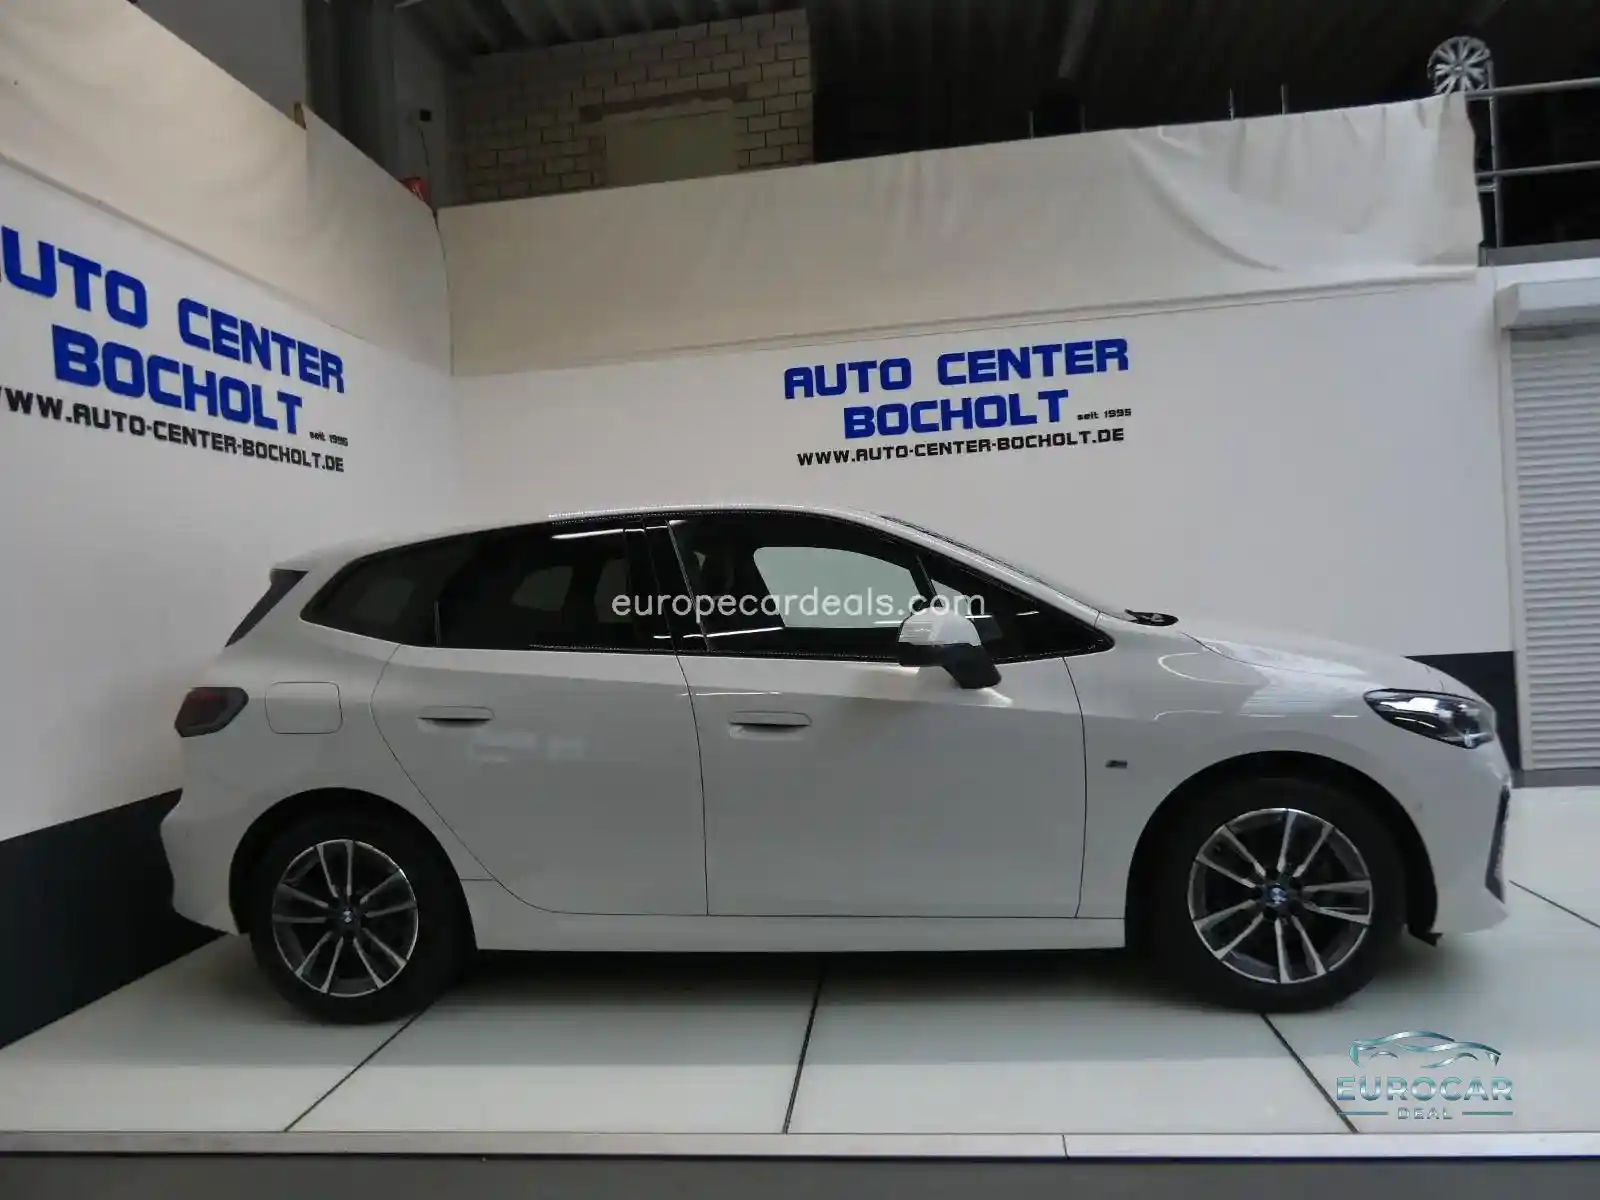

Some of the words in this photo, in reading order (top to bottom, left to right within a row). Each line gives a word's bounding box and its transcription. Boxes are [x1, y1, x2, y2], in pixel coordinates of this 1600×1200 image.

[0, 225, 148, 329] UTO
[177, 297, 345, 393] CENTER
[52, 324, 303, 435] BOCHOLT
[784, 357, 912, 399] AUTO
[937, 338, 1129, 386] CENTER
[0, 386, 345, 473] WW.AUTO-CENTER-BOCHOLT.DE
[843, 389, 1069, 439] BOCHOLT
[1077, 411, 1099, 421] seit
[1104, 408, 1132, 419] 1995
[797, 428, 1125, 466] WWW.AUTO-CENTER-BOCHOLT.DE
